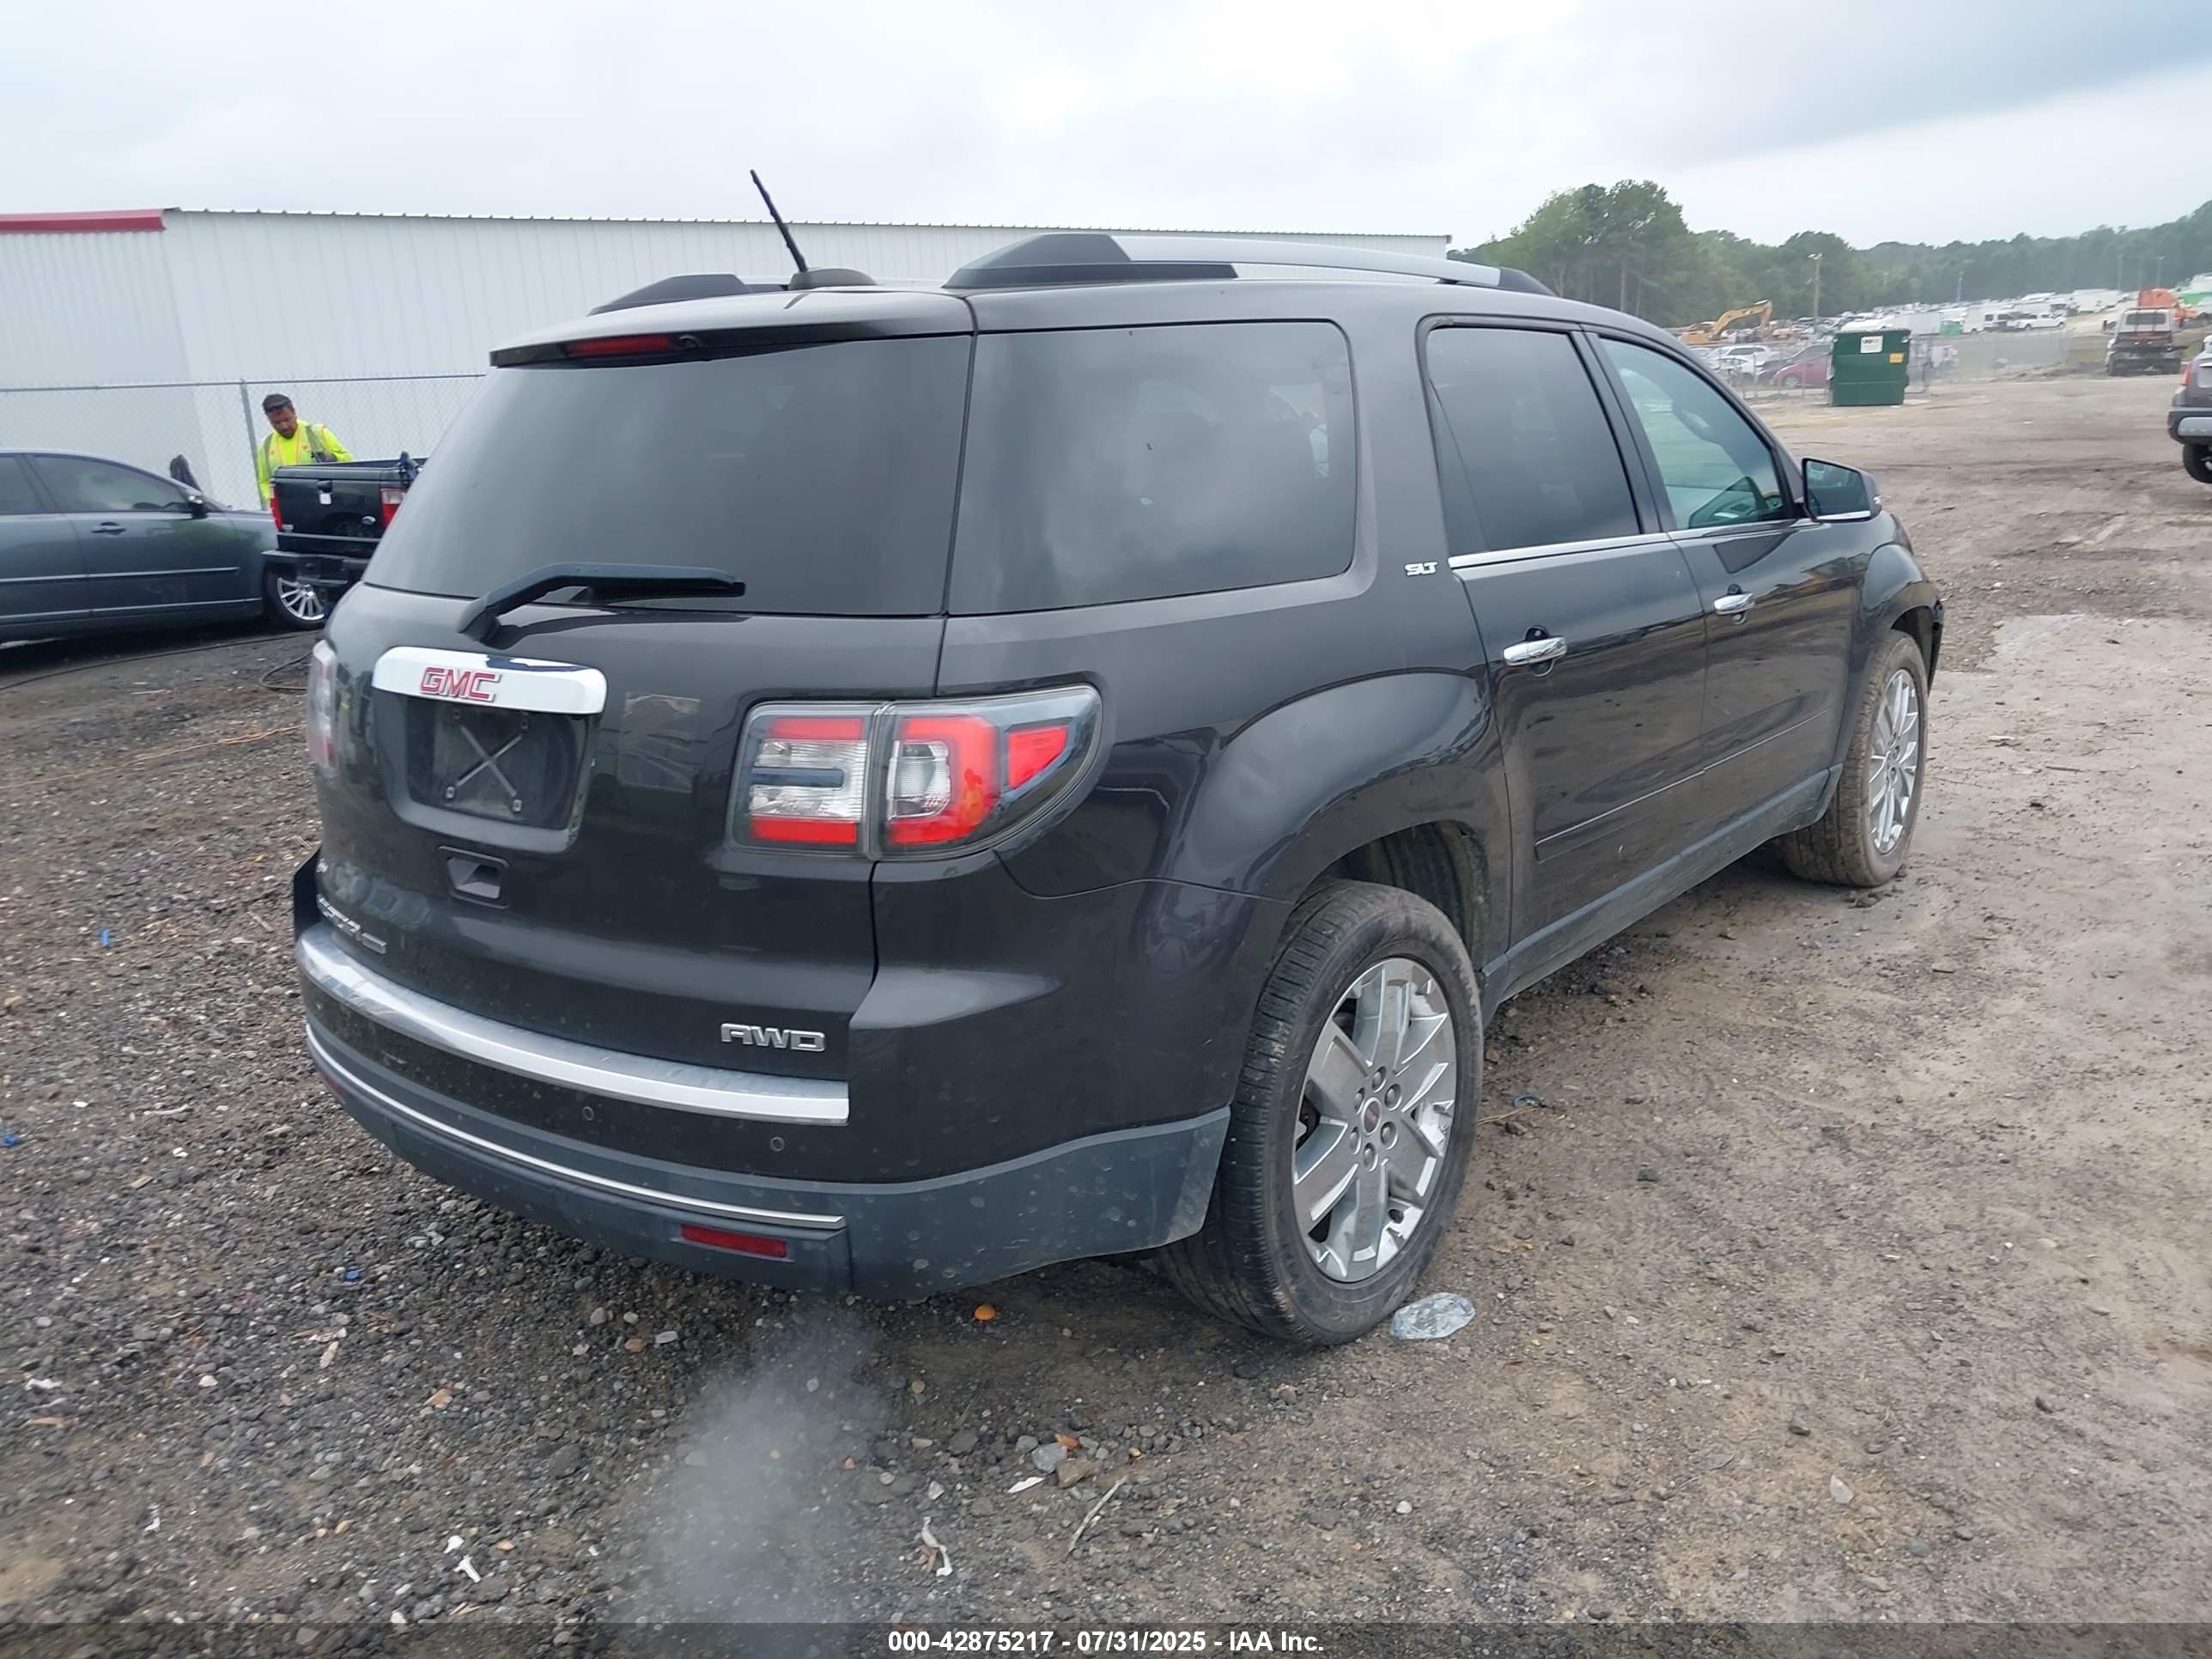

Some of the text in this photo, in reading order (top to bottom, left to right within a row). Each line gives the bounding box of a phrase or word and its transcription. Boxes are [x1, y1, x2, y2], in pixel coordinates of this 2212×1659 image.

[1404, 561, 1438, 577] SLT
[419, 665, 500, 702] GMC
[720, 1023, 825, 1053] AWD
